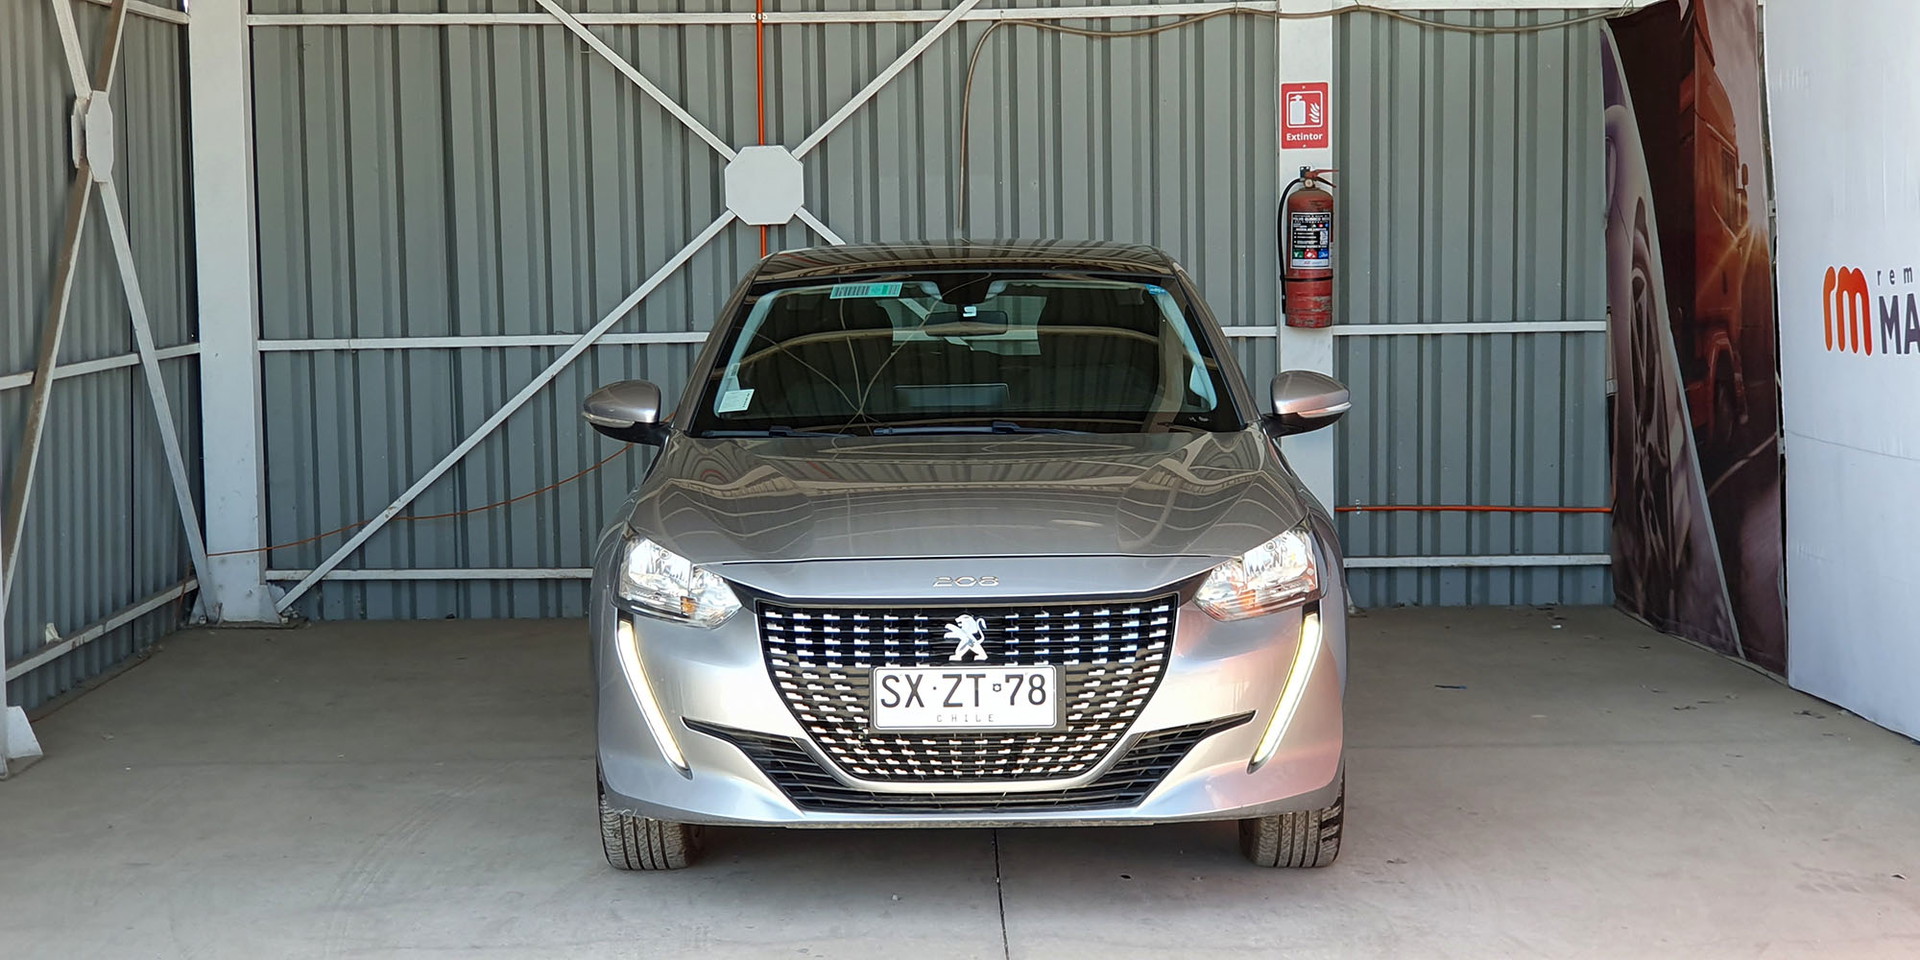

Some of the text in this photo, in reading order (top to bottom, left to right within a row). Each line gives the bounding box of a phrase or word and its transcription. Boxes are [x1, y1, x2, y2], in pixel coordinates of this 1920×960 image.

[1286, 132, 1323, 141] Extintor
[933, 576, 999, 588] 208
[937, 714, 994, 723] CHILE
